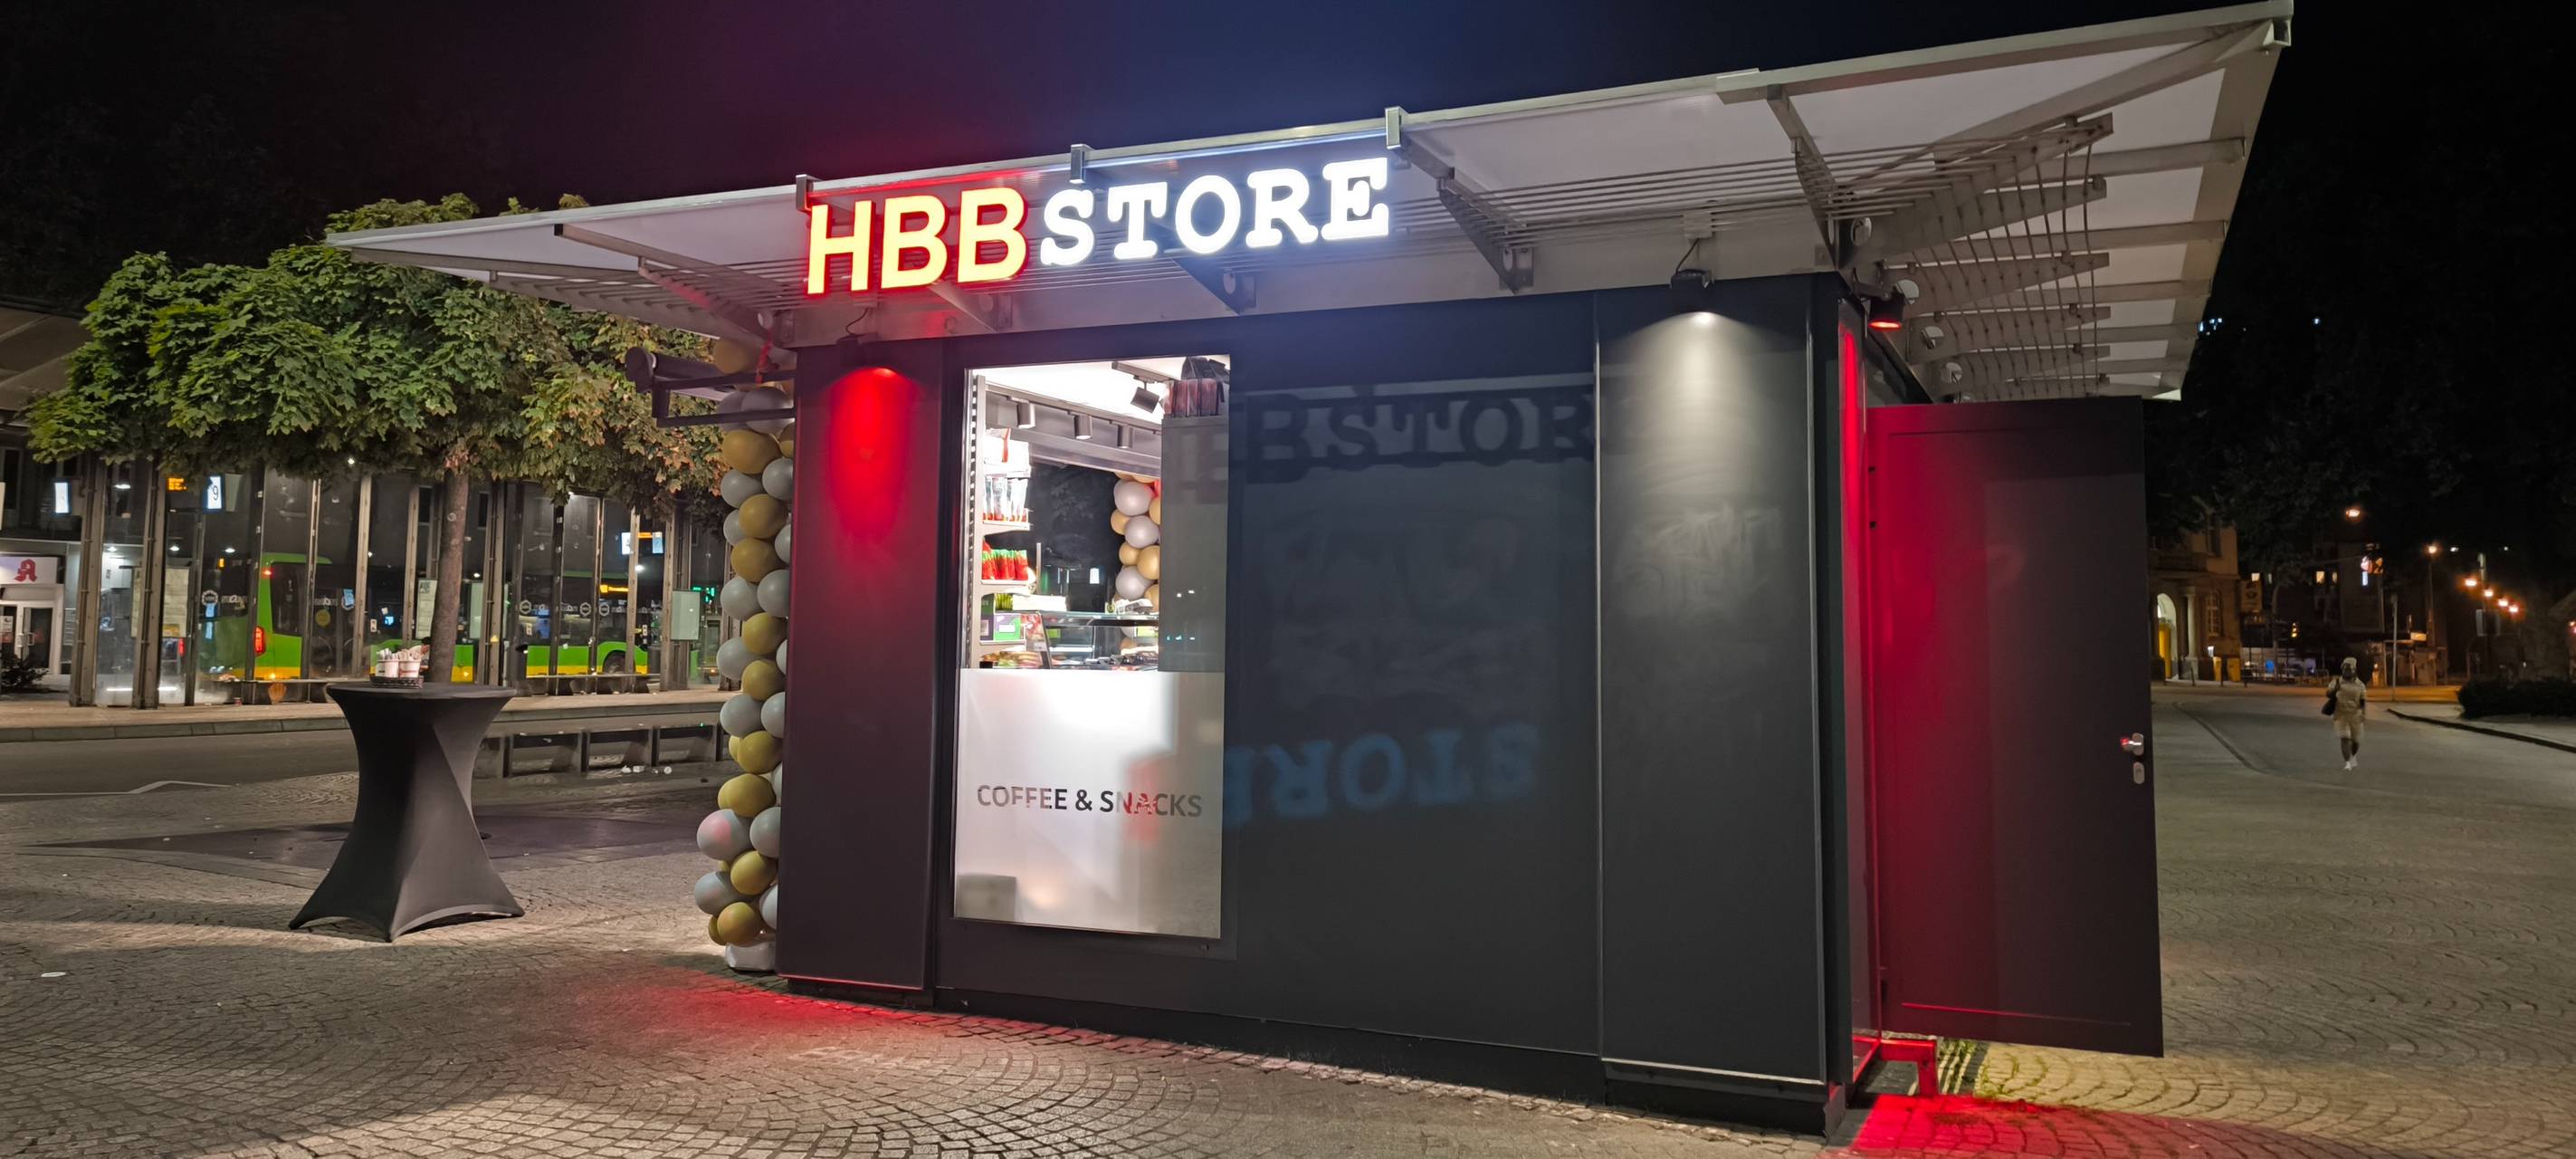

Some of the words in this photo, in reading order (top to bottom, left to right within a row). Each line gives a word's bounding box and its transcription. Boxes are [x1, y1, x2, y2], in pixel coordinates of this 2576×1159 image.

[806, 187, 1026, 294] HBB
[1040, 157, 1389, 266] STORE
[978, 784, 1068, 810] COFFEE
[1074, 789, 1092, 812] &
[1100, 790, 1203, 818] SNACKS
